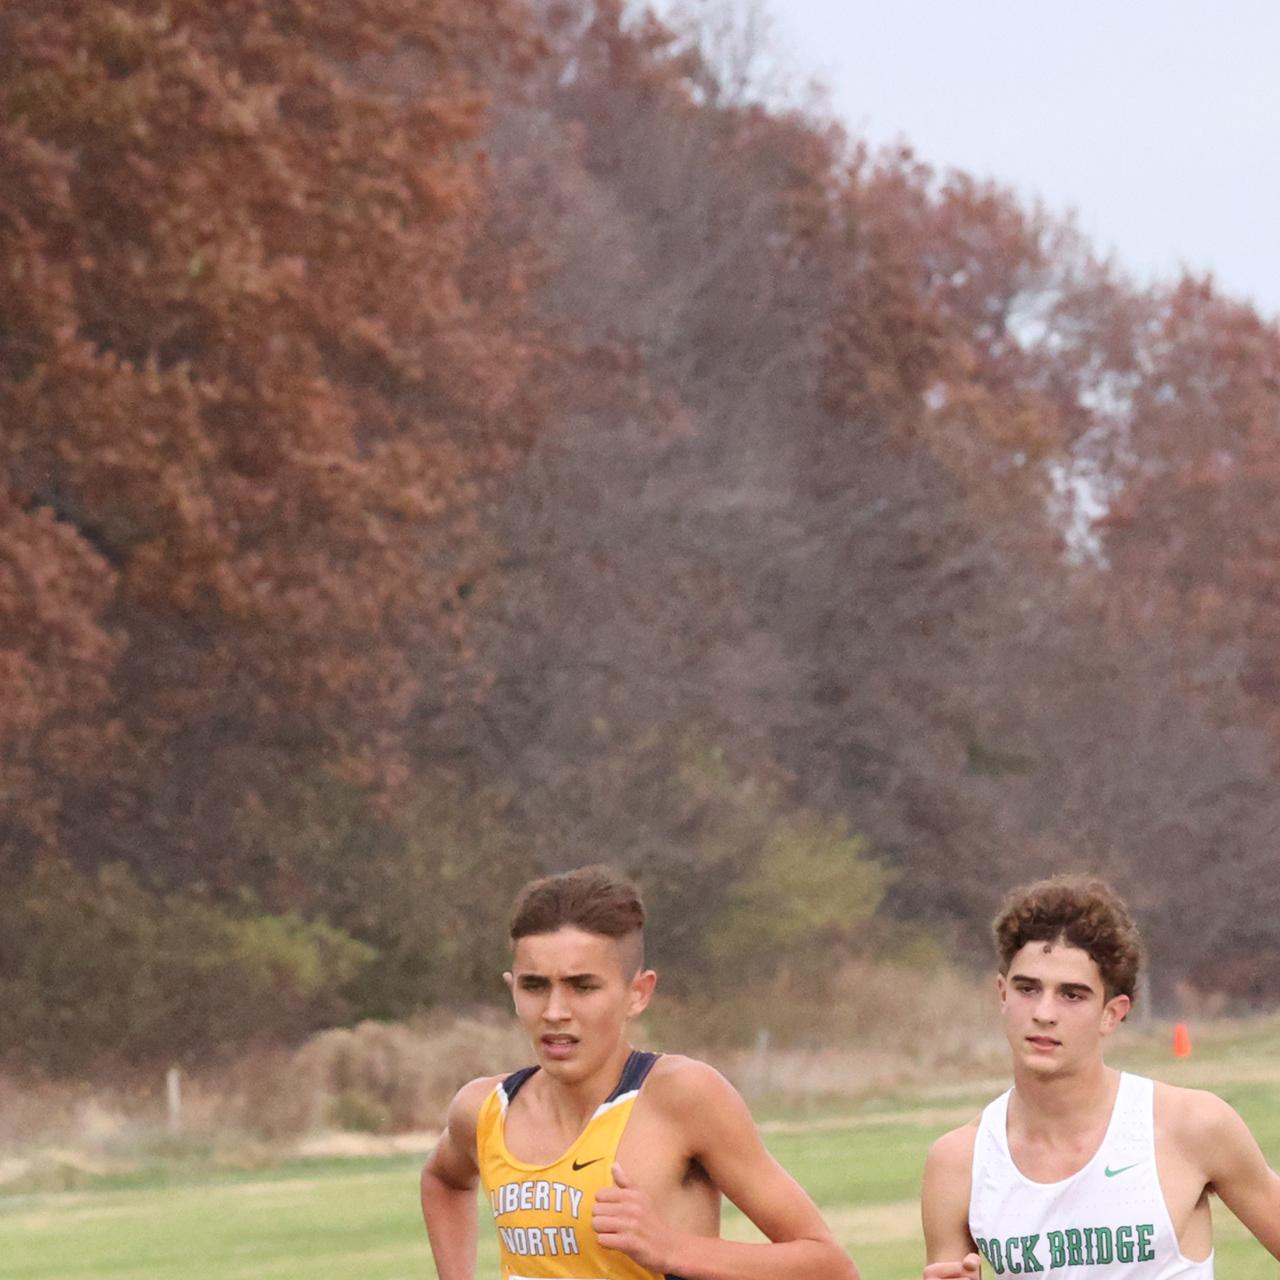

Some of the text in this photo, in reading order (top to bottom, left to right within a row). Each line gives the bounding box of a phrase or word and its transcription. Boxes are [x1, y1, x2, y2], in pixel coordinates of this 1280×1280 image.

[490, 1180, 584, 1219] LIBERTY
[498, 1226, 580, 1256] NORTH
[1047, 1224, 1155, 1270] BRIDGE
